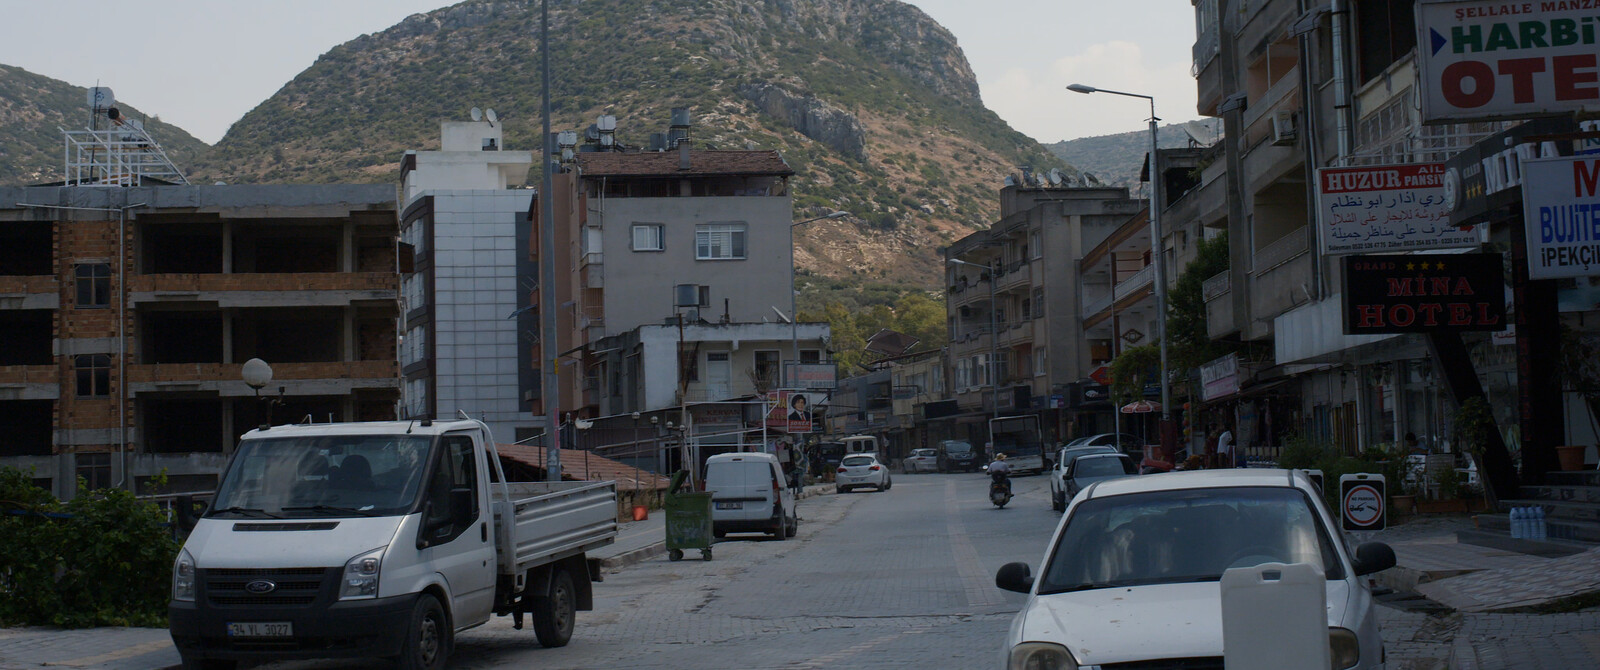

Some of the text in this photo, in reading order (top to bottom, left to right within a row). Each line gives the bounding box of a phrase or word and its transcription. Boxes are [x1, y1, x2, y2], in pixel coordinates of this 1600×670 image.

[1455, 4, 1532, 21] ŞELLALE
[1441, 54, 1599, 109] OTE
[1327, 170, 1402, 191] HUZUR
[1386, 272, 1475, 297] MİNA
[1356, 302, 1501, 328] HOTEL
[233, 624, 245, 635] 34
[265, 624, 288, 636] 3027
